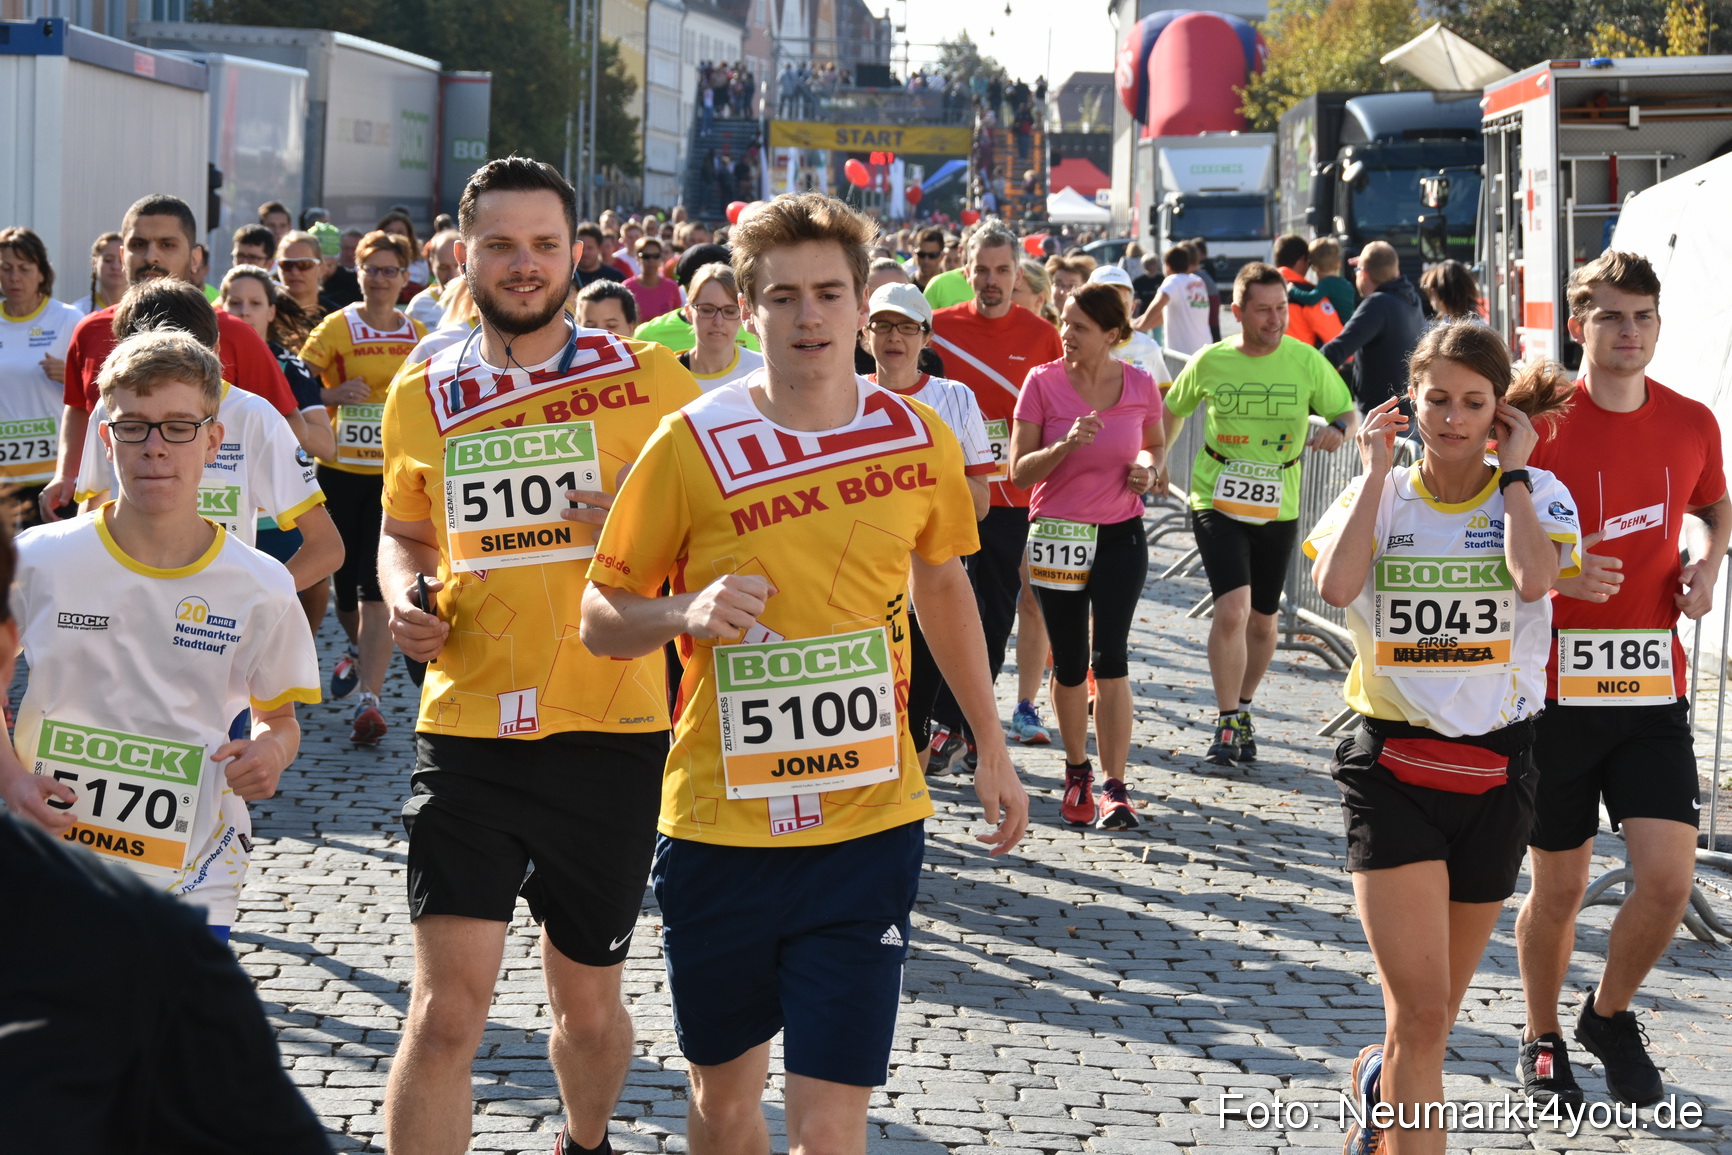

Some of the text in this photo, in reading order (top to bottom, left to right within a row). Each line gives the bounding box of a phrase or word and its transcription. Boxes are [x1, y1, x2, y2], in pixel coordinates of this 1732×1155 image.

[836, 129, 905, 146] START
[354, 346, 385, 356] MAX
[542, 382, 650, 424] BÖGL
[1214, 383, 1297, 415] OPF
[344, 407, 383, 419] BOC
[0, 421, 49, 437] OCK
[346, 425, 382, 444] 509
[1217, 434, 1249, 445] MERZ
[457, 430, 579, 468] BOCK
[1227, 462, 1279, 479] BOCK
[462, 472, 578, 522] 5101
[730, 463, 937, 536] MAX BÖGL
[1222, 479, 1276, 503] 5283
[1033, 522, 1091, 539] BOCK
[1466, 515, 1489, 528] 20
[1620, 514, 1647, 530] DEHN
[481, 527, 571, 552] SIEMON
[1464, 540, 1504, 549] Stadtlau
[1465, 530, 1504, 542] Neumark
[595, 552, 631, 576] egl.de
[1033, 541, 1087, 566] 5119
[1033, 568, 1086, 581] CHRISTIANE
[1386, 562, 1501, 586] BOCK
[58, 612, 110, 627] BOCK
[178, 602, 234, 628] 20 JAHRE
[1389, 599, 1498, 635] 5043
[175, 623, 241, 643] Neumarkter
[173, 636, 227, 655] Stadtlauf
[1394, 647, 1496, 663] MURTAZA
[1573, 640, 1660, 670] 5186
[729, 638, 874, 683] BOCK
[1597, 681, 1640, 693] NICO
[742, 686, 877, 744] 5100
[52, 728, 187, 777] BOCK
[771, 750, 860, 777] JONAS
[47, 770, 177, 830] 5170
[64, 827, 145, 857] JONAS
[220, 826, 235, 848] 2019
[880, 936, 903, 947] adidas
